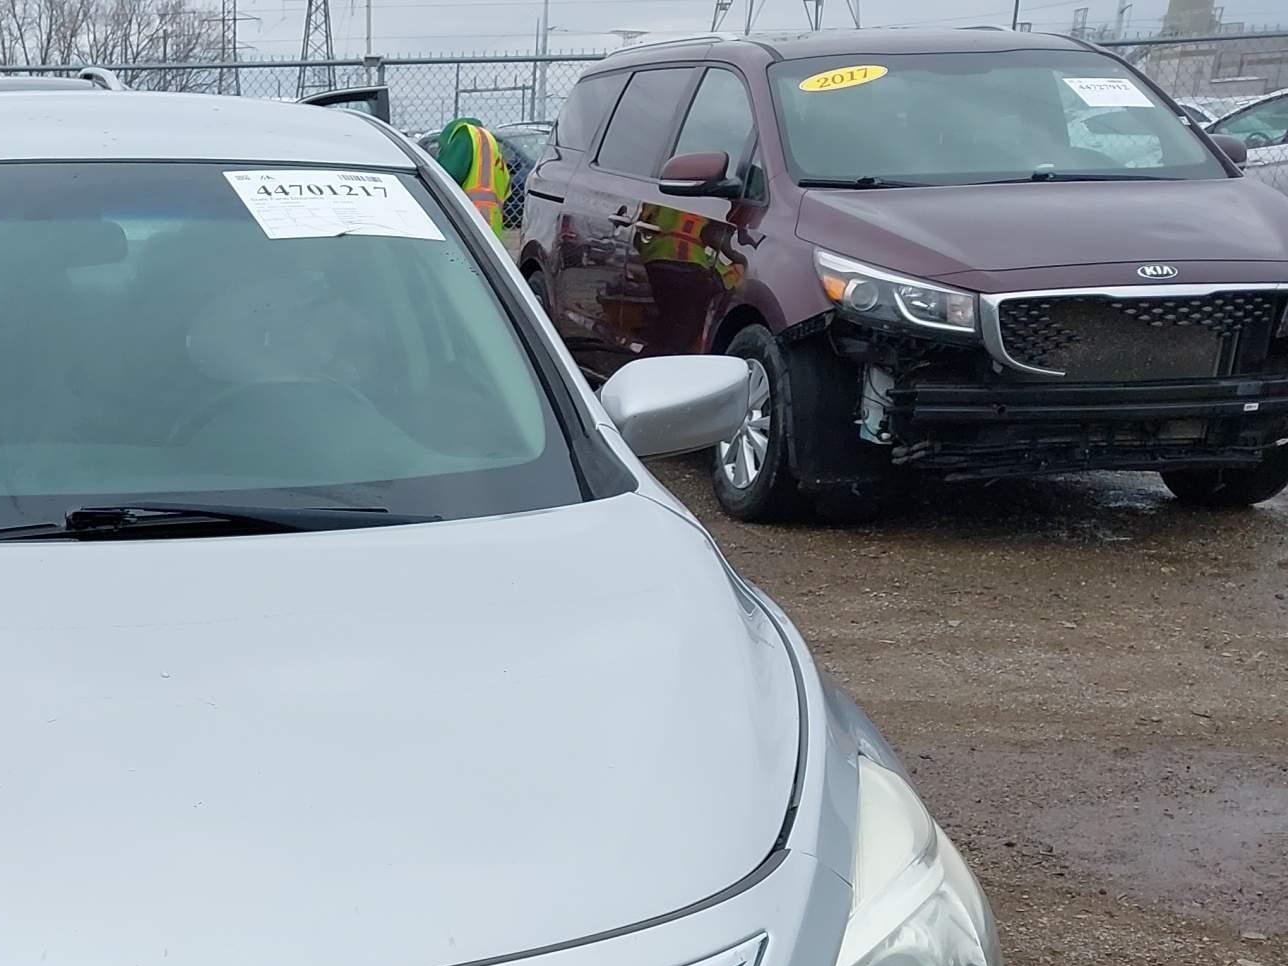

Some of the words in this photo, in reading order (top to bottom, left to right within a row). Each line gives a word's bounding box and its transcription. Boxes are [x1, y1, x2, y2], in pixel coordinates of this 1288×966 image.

[816, 67, 868, 88] 2017
[256, 184, 388, 198] 44701217
[1143, 265, 1174, 276] KIA
